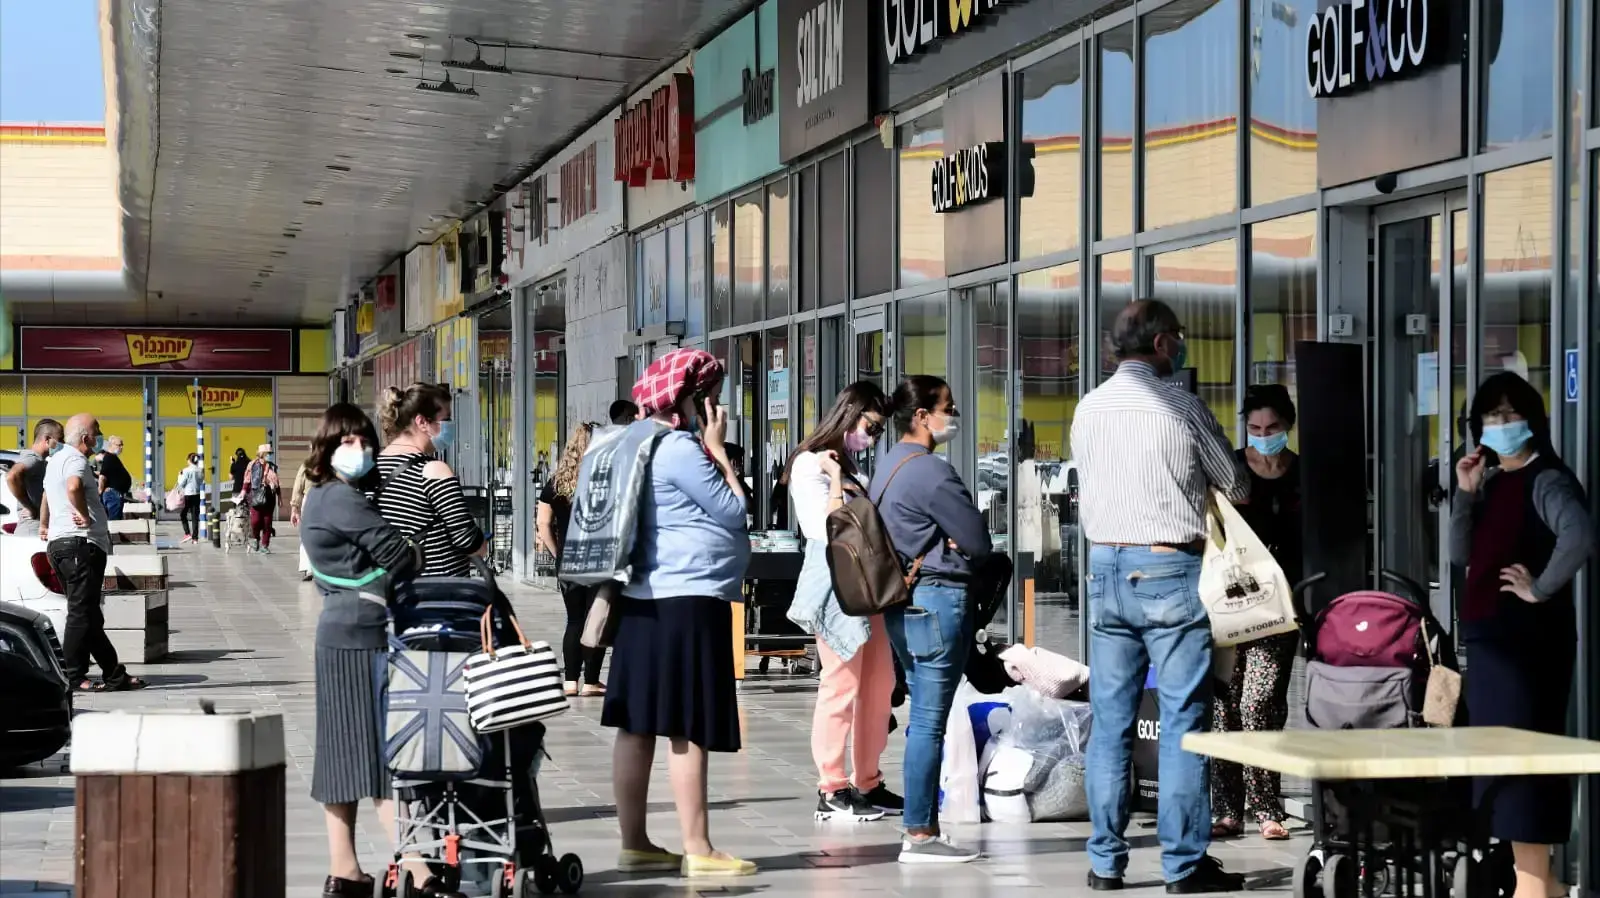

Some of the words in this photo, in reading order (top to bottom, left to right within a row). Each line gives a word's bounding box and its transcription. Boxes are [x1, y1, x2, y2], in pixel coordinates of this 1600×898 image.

[796, 0, 844, 109] SOLTAM
[931, 142, 989, 214] GOLF&KIDS
[132, 335, 187, 357] יוחננוף
